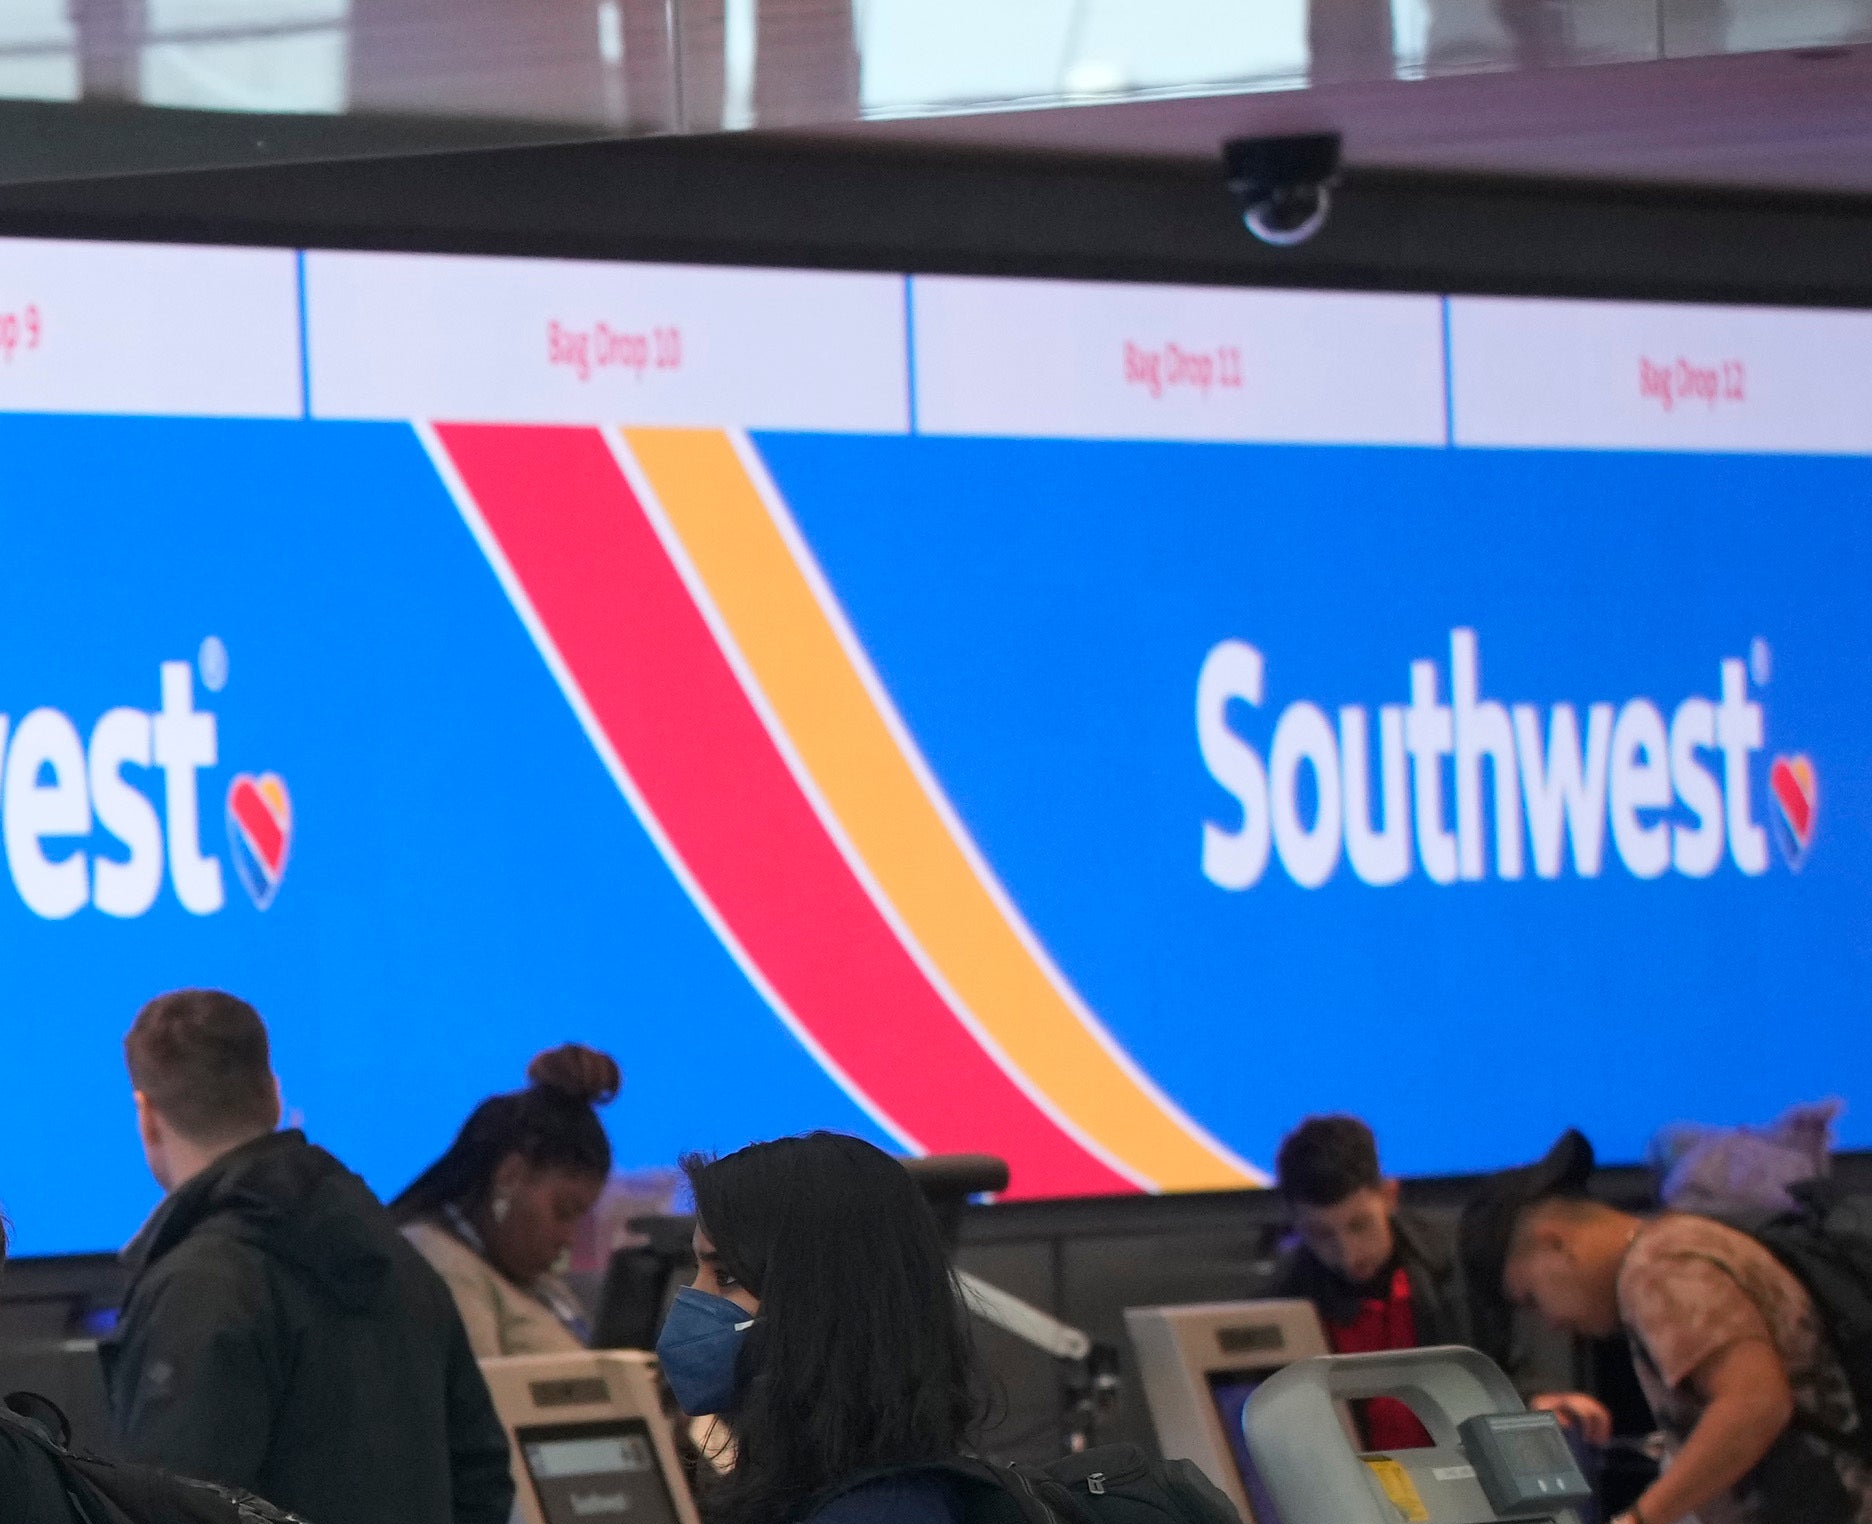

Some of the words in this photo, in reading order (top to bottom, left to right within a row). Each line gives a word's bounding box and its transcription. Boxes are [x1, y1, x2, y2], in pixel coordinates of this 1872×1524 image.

[548, 319, 590, 382] Bag
[596, 321, 647, 384] Drop
[1196, 628, 1768, 891] Southwest
